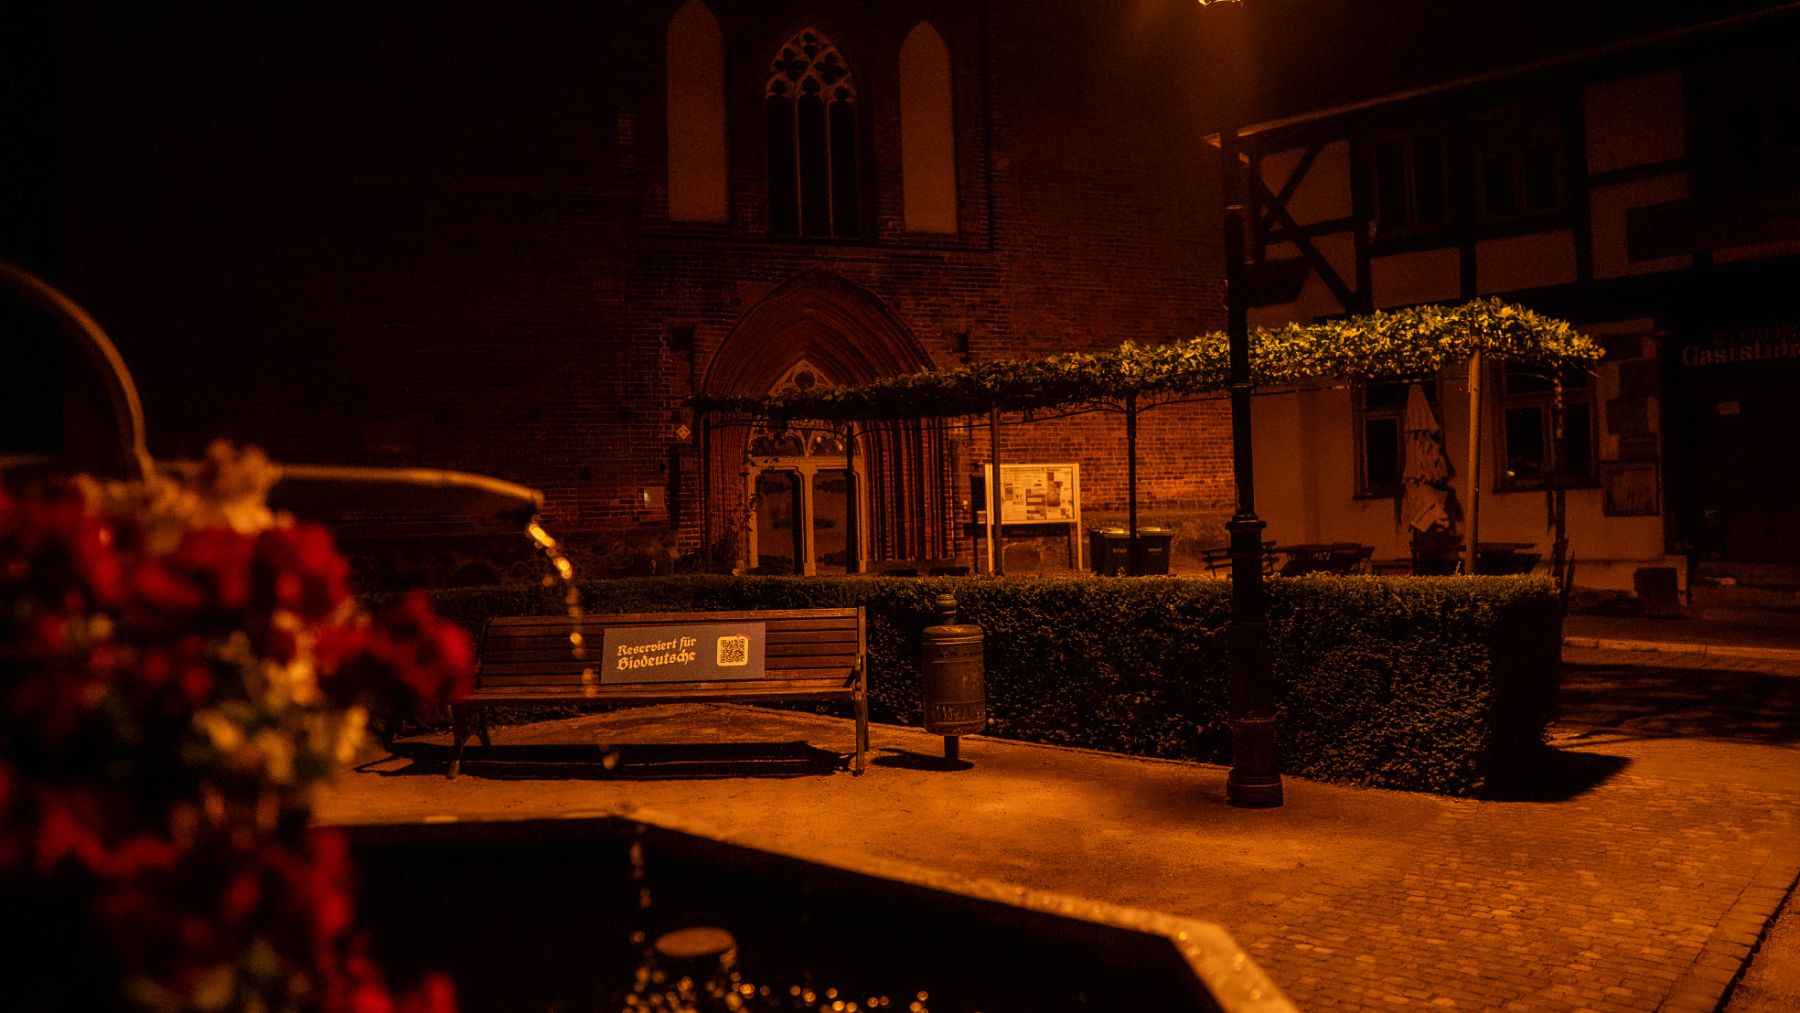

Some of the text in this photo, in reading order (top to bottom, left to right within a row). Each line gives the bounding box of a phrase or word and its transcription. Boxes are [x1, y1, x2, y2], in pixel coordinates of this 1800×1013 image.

[617, 636, 697, 656] Reserviert für
[616, 649, 697, 671] Biodeutsche
